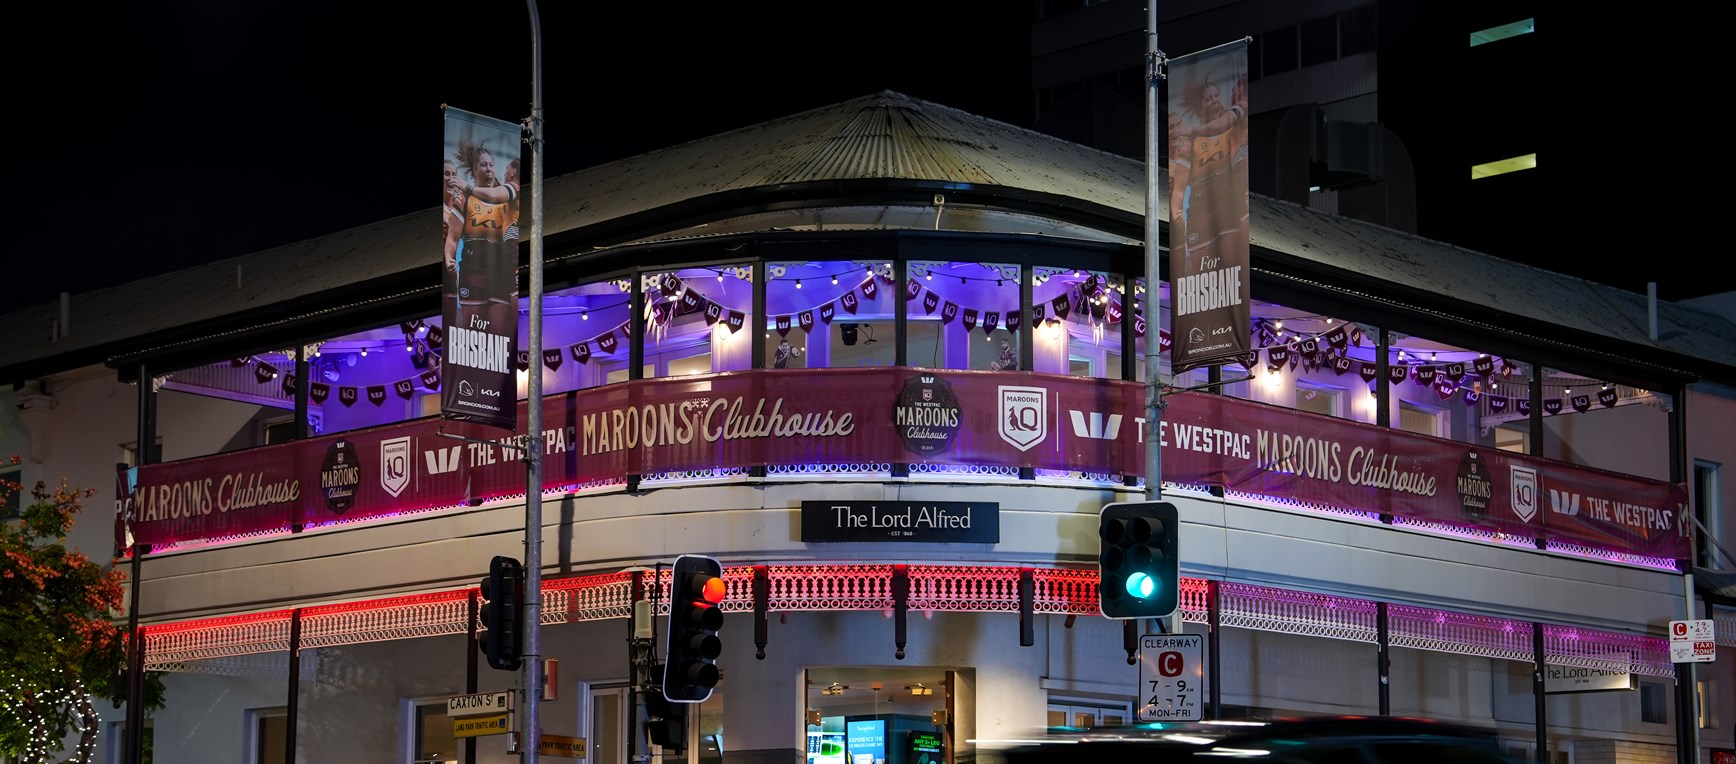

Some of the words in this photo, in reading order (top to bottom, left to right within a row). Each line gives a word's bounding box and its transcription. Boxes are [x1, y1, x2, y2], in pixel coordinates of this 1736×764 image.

[1200, 255, 1221, 271] For
[1177, 265, 1242, 317] BRISBANE
[470, 314, 490, 330] For
[448, 325, 510, 374] BRISBANE
[1006, 395, 1039, 404] MAROONS
[896, 406, 958, 427] MAROONS
[468, 439, 496, 468] THE
[582, 401, 693, 456] MAROONS
[703, 396, 855, 443] Clubhouse
[907, 426, 948, 440] Clubhouse
[385, 446, 406, 454] MAROONS
[1134, 417, 1168, 447] TE
[1173, 422, 1250, 460] WESTPAC
[1256, 429, 1342, 483] MAROONS
[1347, 446, 1437, 497] Clubhouse
[321, 466, 359, 488] MAROONS
[1457, 476, 1491, 499] MAROONS
[134, 477, 213, 523] MAROONS
[218, 472, 300, 513] Clubhouse
[831, 506, 868, 528] The
[871, 505, 911, 528] Lord
[914, 506, 971, 529] Alfred
[1586, 496, 1611, 522] THE
[1612, 501, 1673, 530] WESTPAC
[1676, 623, 1684, 635] C
[1144, 638, 1199, 649] CLEARWAY
[1164, 654, 1177, 675] C
[1547, 664, 1561, 679] he
[450, 695, 483, 709] CAXTON
[1149, 709, 1191, 717] MON-FRI
[474, 721, 488, 729] TRAFFIC
[489, 720, 498, 728] AREA
[541, 741, 553, 749] PARK
[573, 743, 585, 752] AREA
